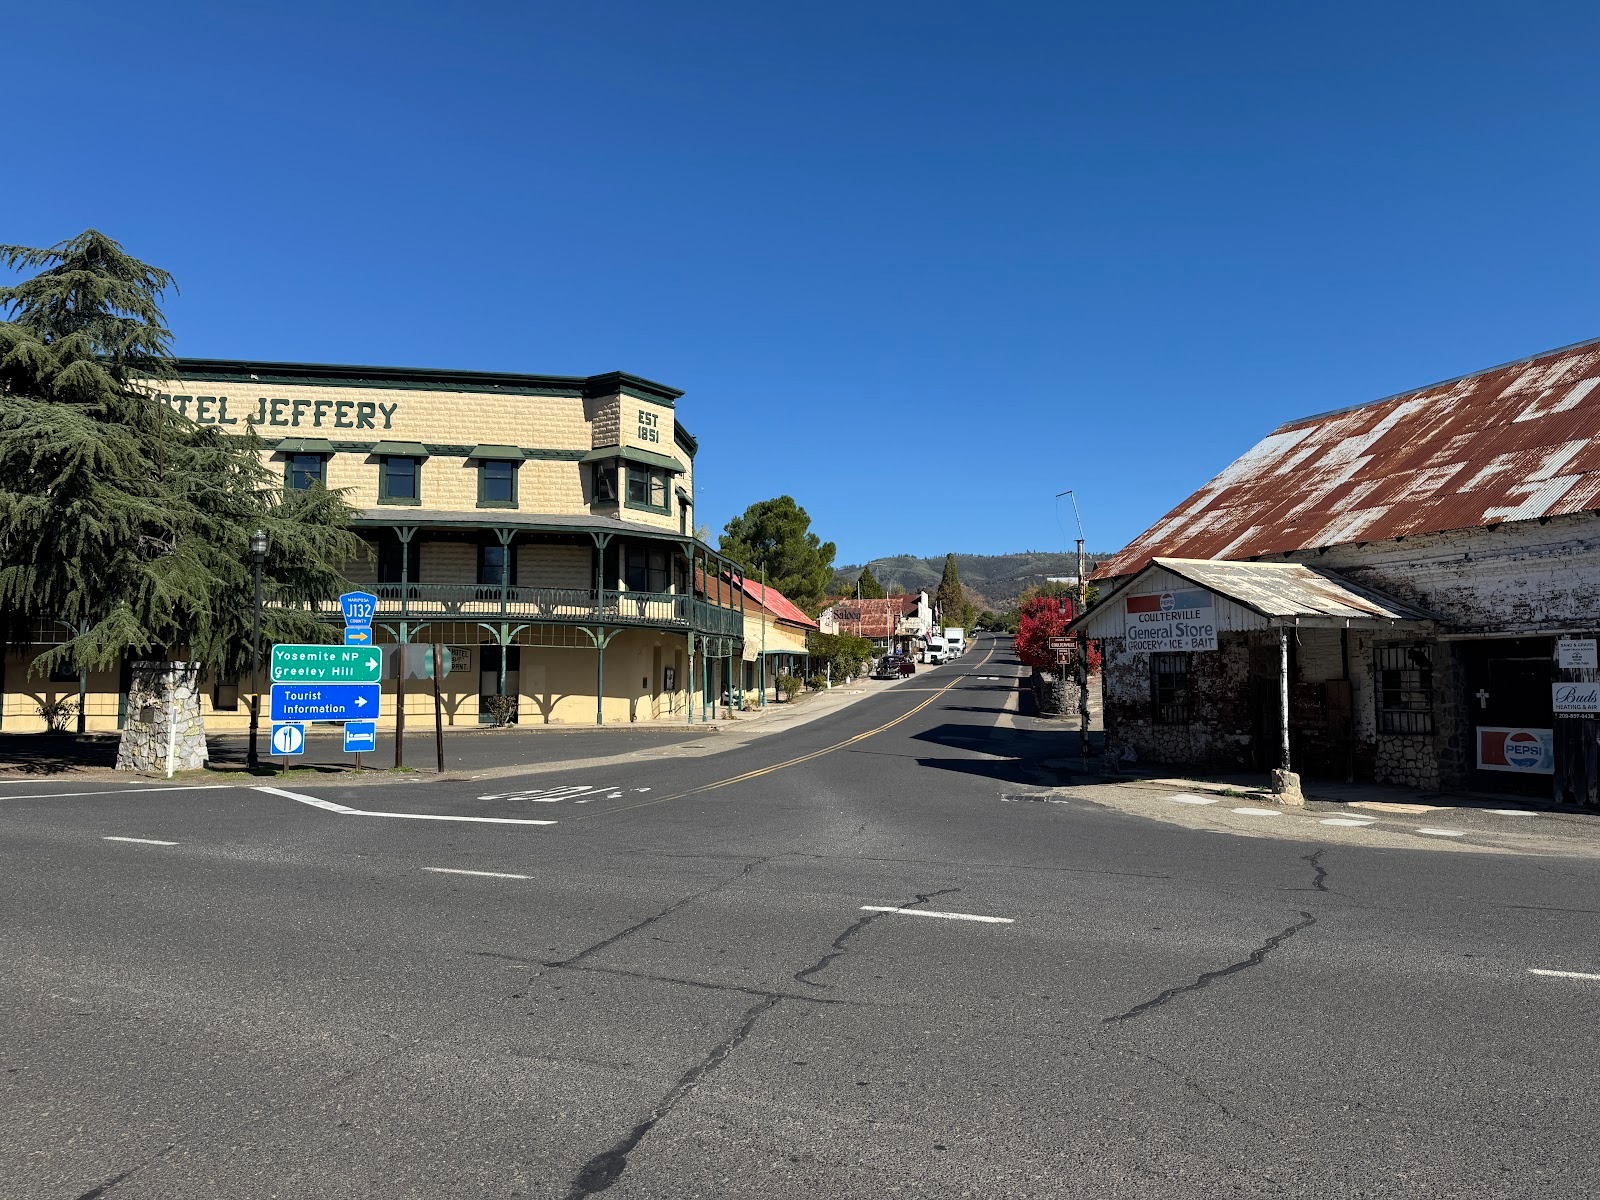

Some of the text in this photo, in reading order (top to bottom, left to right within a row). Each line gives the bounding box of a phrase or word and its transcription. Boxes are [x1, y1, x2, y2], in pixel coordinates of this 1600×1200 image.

[257, 398, 397, 429] JEFFERY
[638, 409, 659, 427] EST
[637, 425, 659, 443] 1851
[346, 603, 372, 618] J132
[833, 610, 861, 620] Saloon
[1139, 610, 1200, 622] COULTERVILLE
[1128, 623, 1213, 640] General Store
[1128, 638, 1214, 651] GROCERY ICE BAIT
[275, 651, 360, 661] Yosemite NP
[274, 666, 354, 678] Greeley Hill
[284, 691, 322, 700] Tourist
[1556, 686, 1597, 703] Buds
[283, 704, 346, 714] Information
[1505, 744, 1542, 756] PEPSI
